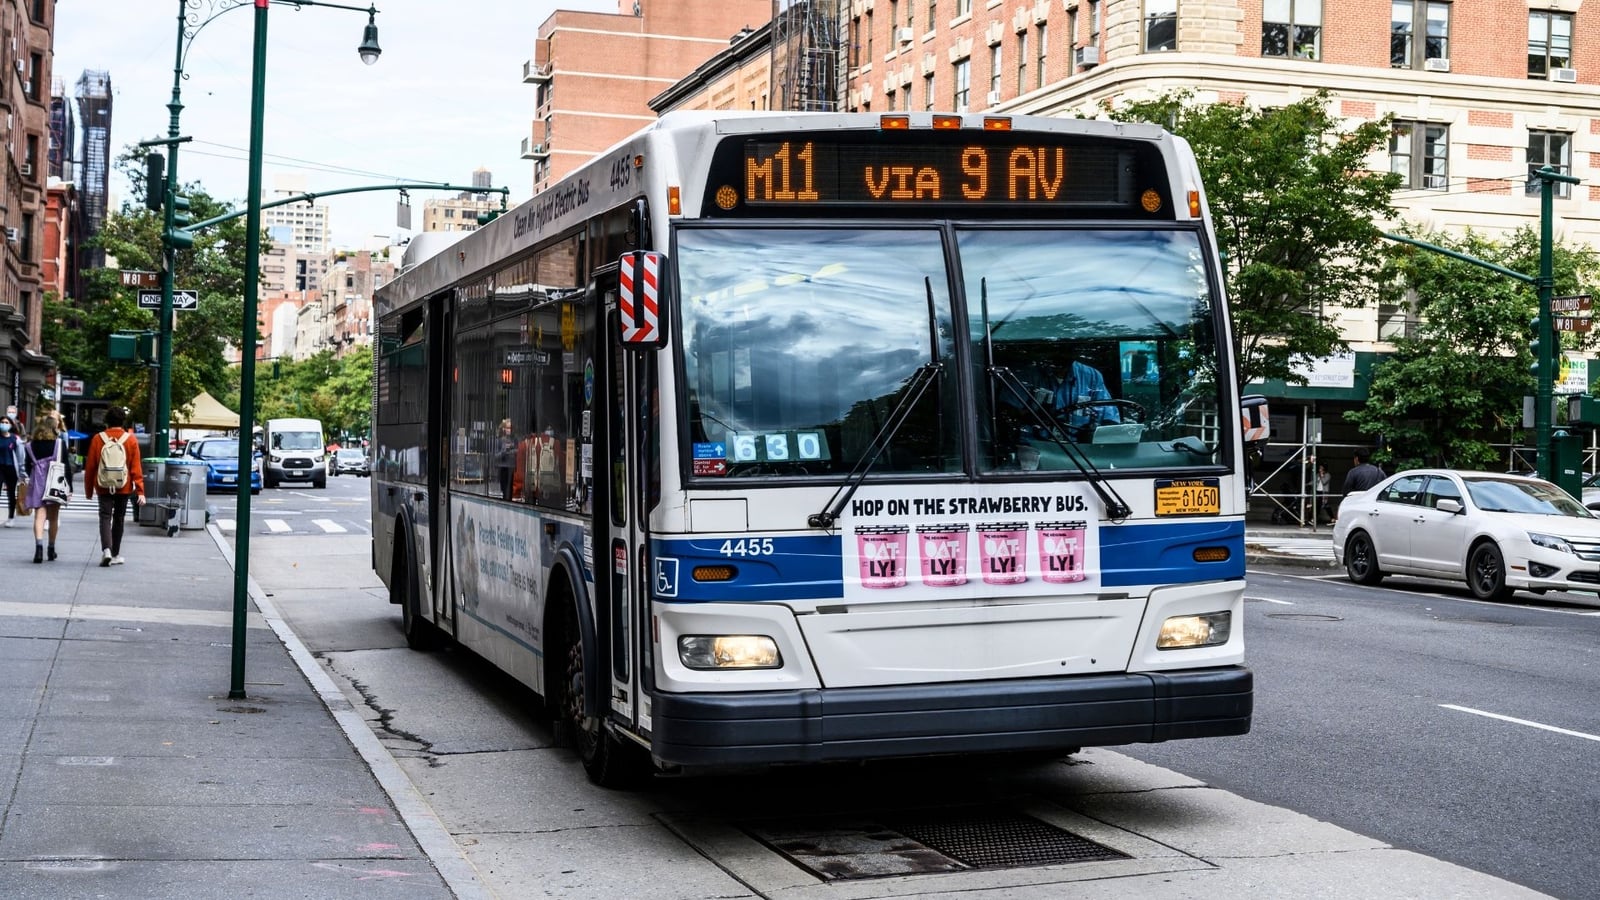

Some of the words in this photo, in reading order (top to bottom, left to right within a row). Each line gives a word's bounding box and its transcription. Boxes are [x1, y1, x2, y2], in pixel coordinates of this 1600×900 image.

[609, 154, 631, 193] 4455
[747, 142, 818, 200] M11
[865, 166, 940, 199] VIA
[961, 147, 987, 199] 9
[1009, 147, 1063, 199] AV
[513, 213, 528, 239] Clean
[526, 206, 536, 234] Air
[535, 196, 554, 234] Hybrid
[553, 182, 577, 220] Electric
[577, 178, 590, 207] Bus
[122, 272, 131, 284] W
[131, 273, 141, 285] 81
[1551, 298, 1580, 311] COLUMBUS
[1556, 318, 1564, 330] W
[1564, 318, 1574, 331] 81
[852, 499, 884, 516] HOP
[887, 499, 909, 516] ON
[913, 498, 945, 515] THE
[949, 496, 1052, 515] STRAWBERRY
[1056, 495, 1089, 512] BUS.
[1190, 489, 1217, 507] 1650
[719, 538, 775, 557] 4455
[869, 560, 896, 577] LY!
[930, 558, 957, 576] LY!
[990, 556, 1016, 573] LY!
[1049, 555, 1074, 572] LY!
